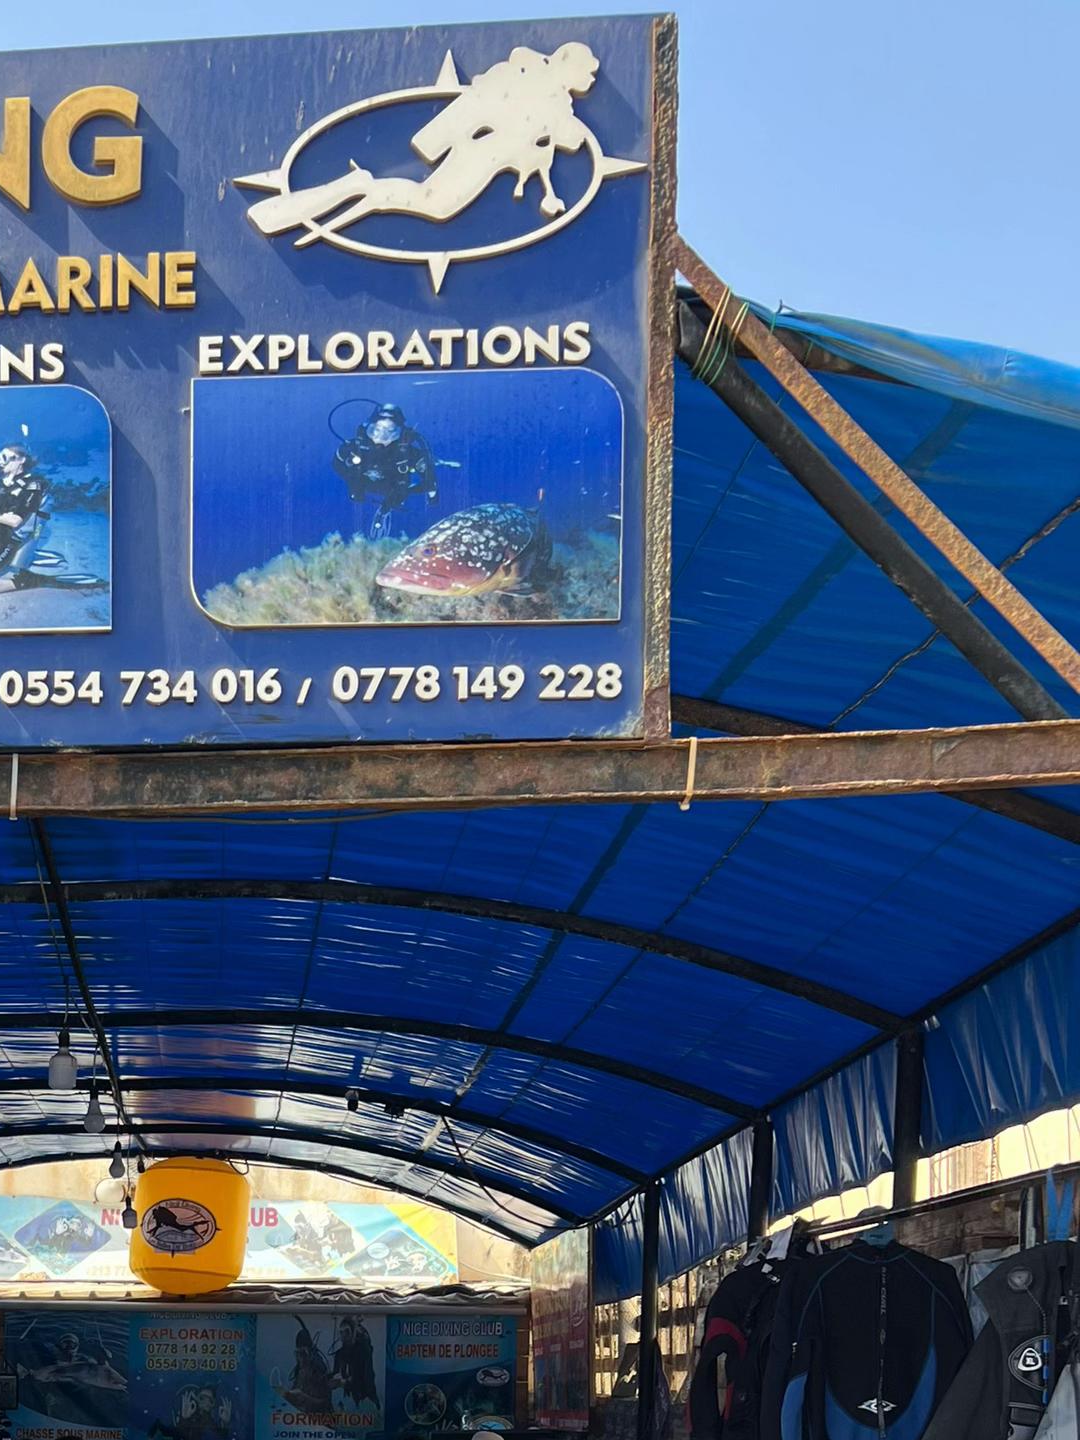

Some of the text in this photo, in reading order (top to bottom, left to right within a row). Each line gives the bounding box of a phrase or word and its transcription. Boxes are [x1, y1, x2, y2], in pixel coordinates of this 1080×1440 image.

[198, 321, 592, 375] EXPLORATIONS
[120, 667, 198, 705] 734
[211, 667, 282, 703] 016
[332, 666, 440, 702] 0778
[452, 664, 524, 700] 149
[538, 663, 623, 700] 228
[250, 1207, 278, 1227] UB
[140, 1328, 244, 1340] EXPLORATION
[403, 1321, 503, 1336] NICE DIVING CLUB
[148, 1343, 236, 1355] 0778 14 92 28
[397, 1344, 499, 1358] BAPTEM DE PLONGEE
[147, 1358, 236, 1369] 0554 73 40 16
[272, 1412, 373, 1425] FORMATION
[16, 1427, 122, 1440] CHASSE SOUS MARINE
[273, 1430, 300, 1439] JOIN
[302, 1430, 323, 1439] THE
